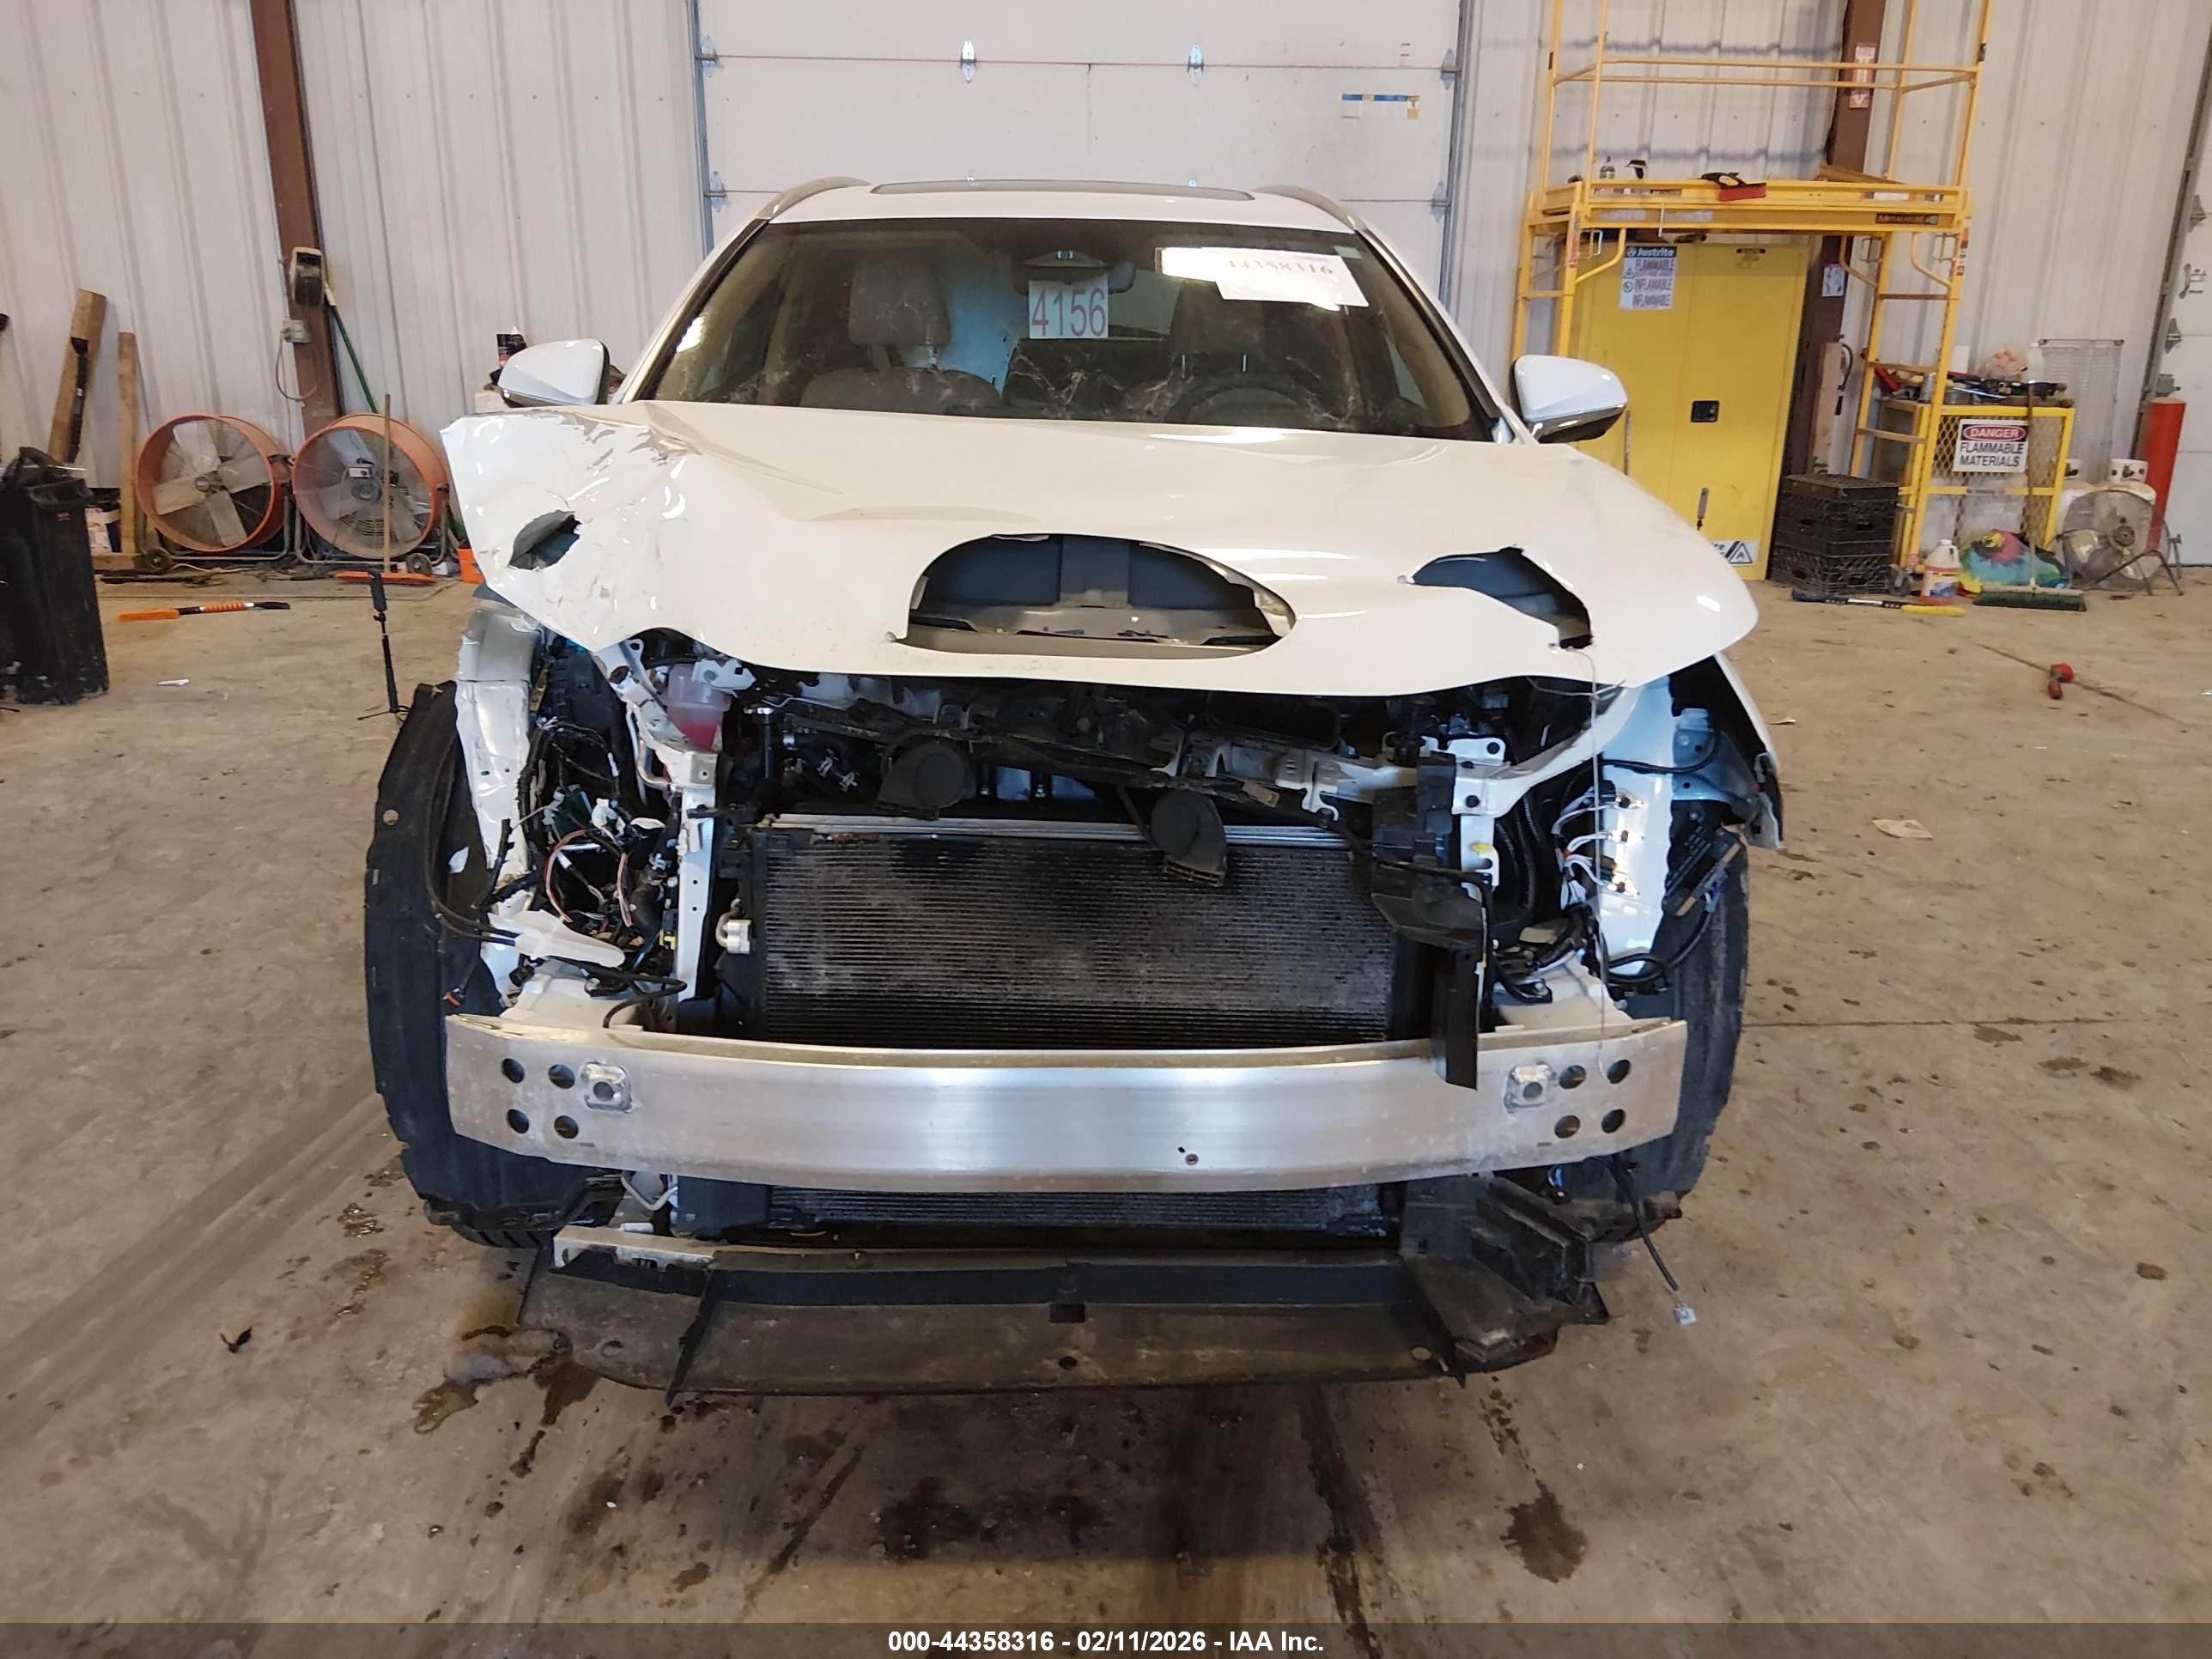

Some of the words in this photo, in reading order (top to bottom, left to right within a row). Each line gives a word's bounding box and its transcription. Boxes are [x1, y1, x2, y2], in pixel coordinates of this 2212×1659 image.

[1637, 247, 1674, 257] Justrite
[1030, 287, 1106, 337] 4156
[1969, 428, 2019, 438] DANGER
[1960, 442, 2024, 454] FLAMMABLE
[1959, 455, 2021, 467] MATERIALS
